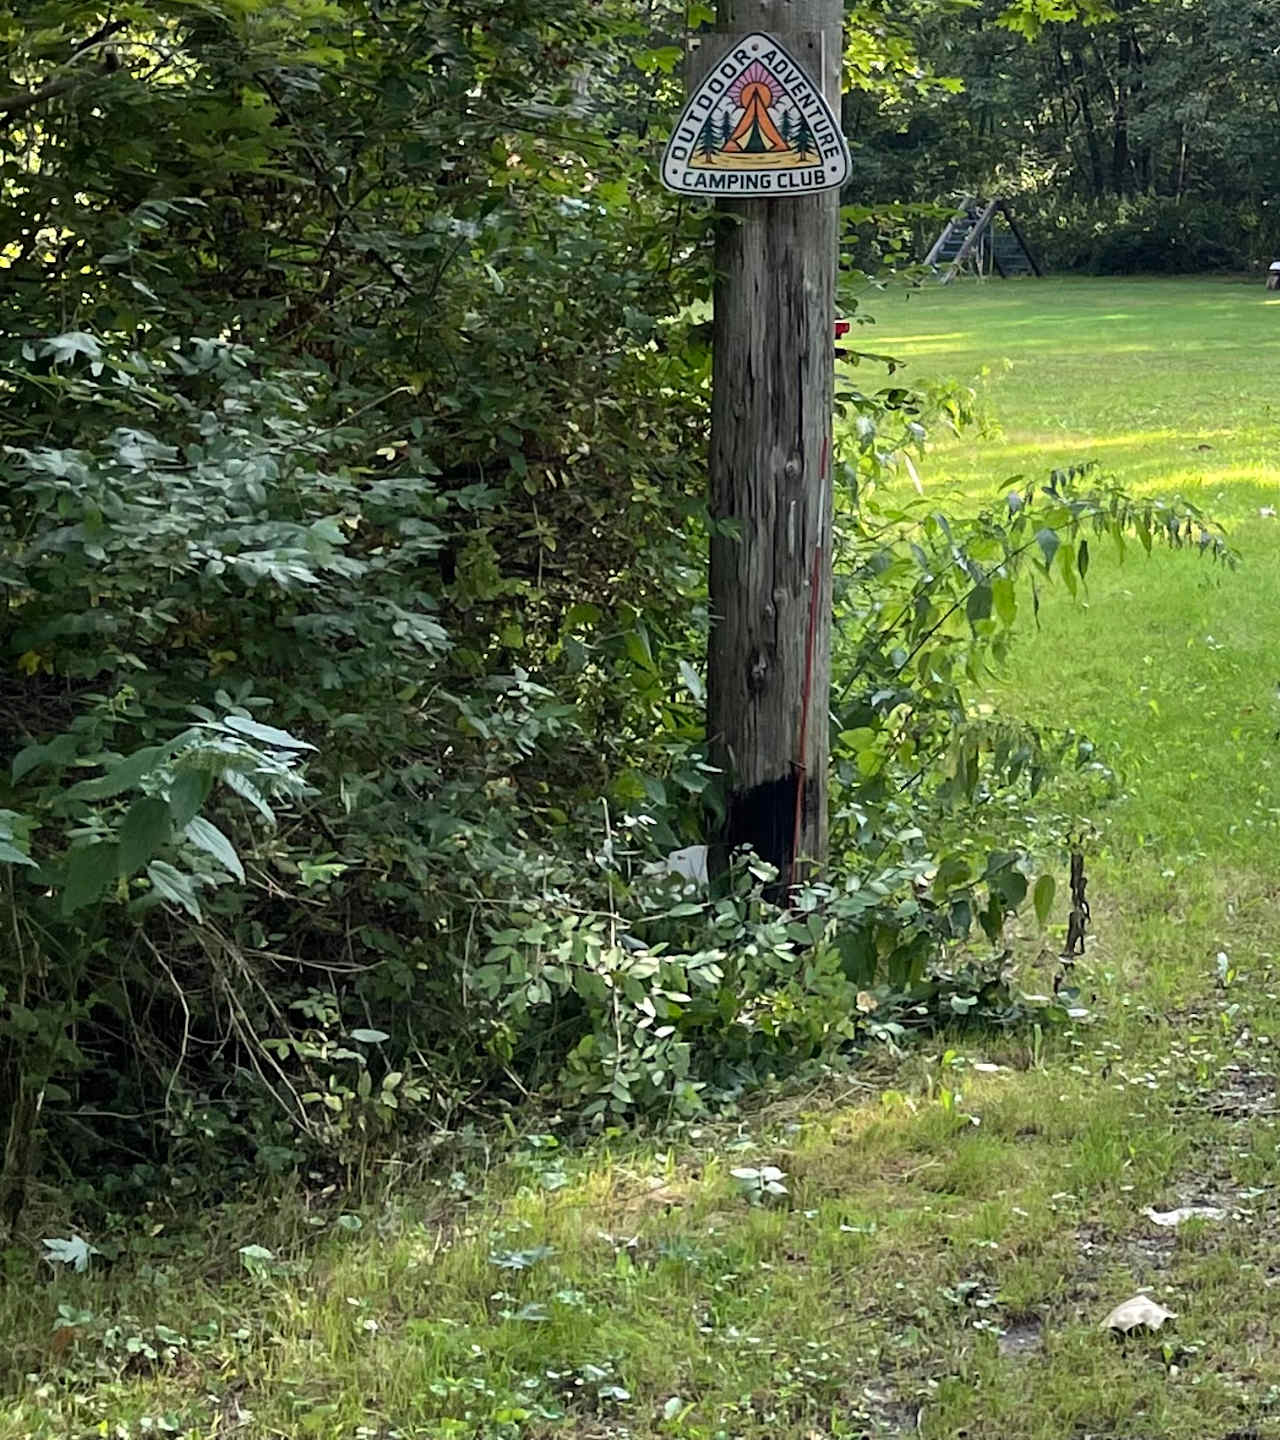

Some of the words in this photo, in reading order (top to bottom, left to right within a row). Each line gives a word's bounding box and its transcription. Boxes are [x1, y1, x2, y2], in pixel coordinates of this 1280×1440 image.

[672, 49, 751, 161] OUTDOOR
[761, 50, 839, 160] ADVENTURE
[683, 171, 770, 189] CAMPING
[778, 169, 825, 187] CLUB
